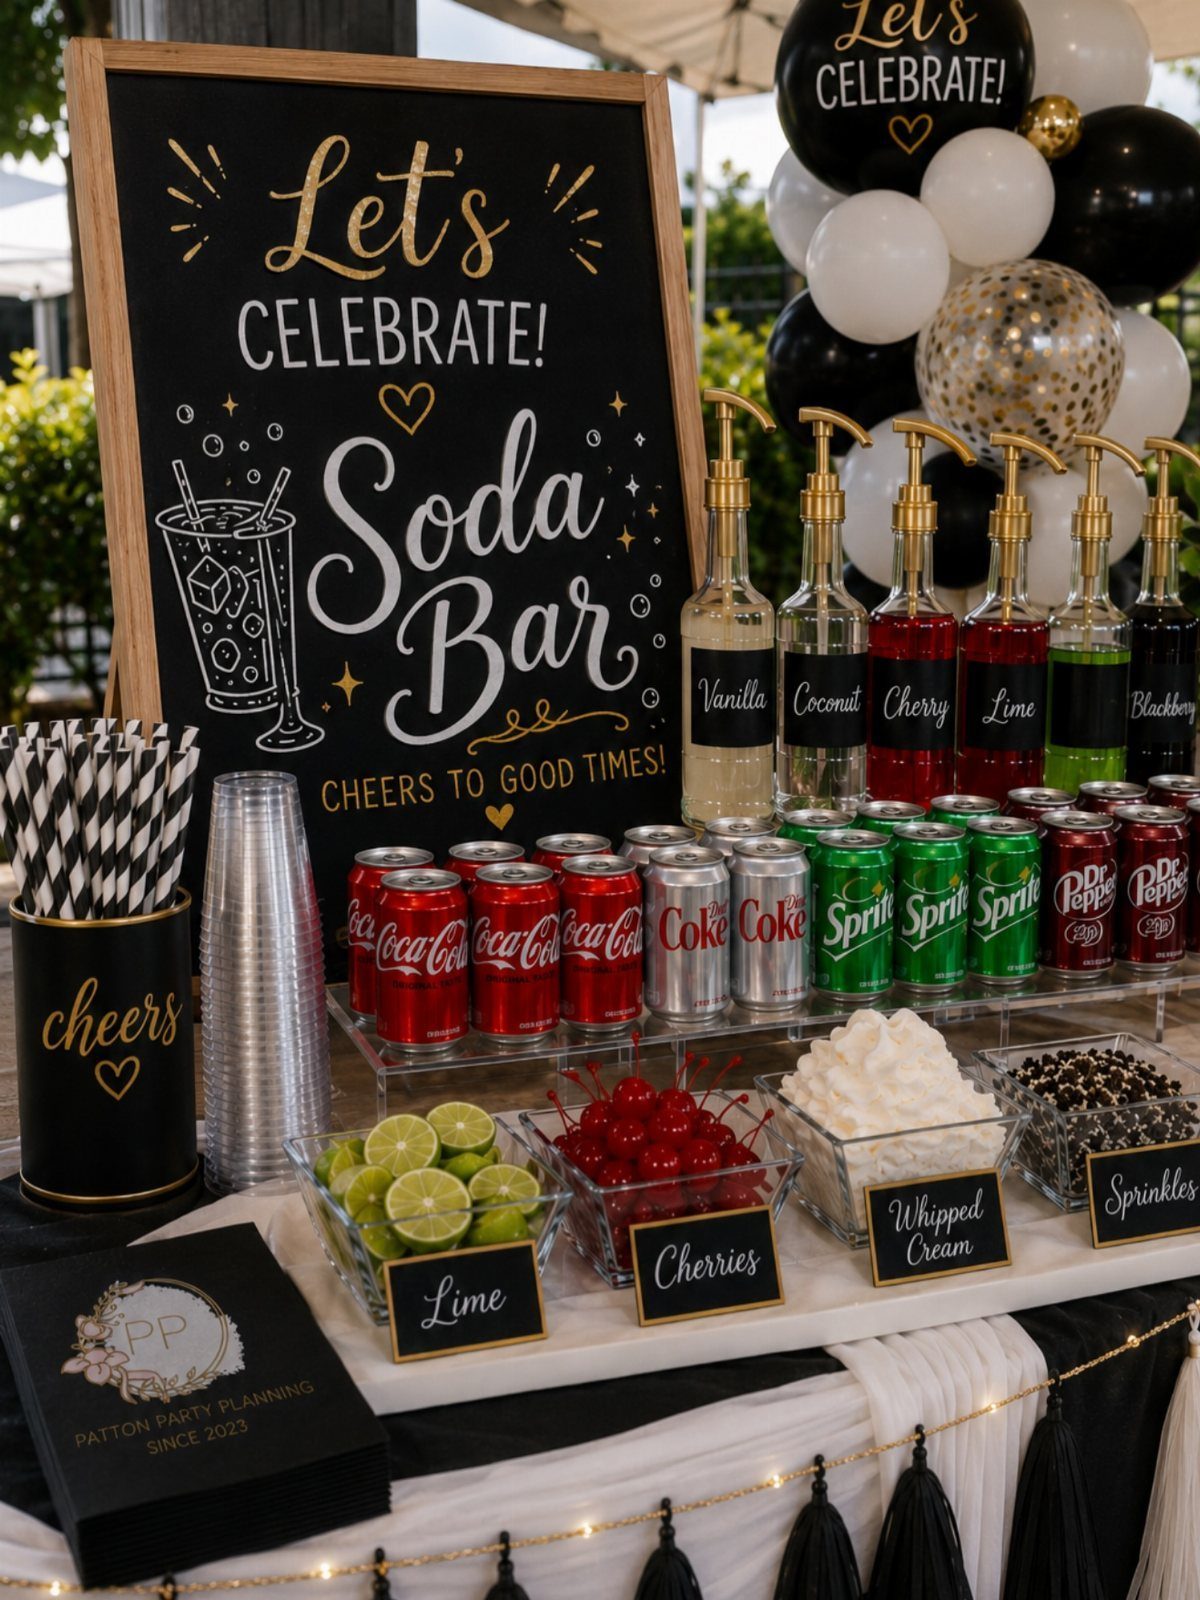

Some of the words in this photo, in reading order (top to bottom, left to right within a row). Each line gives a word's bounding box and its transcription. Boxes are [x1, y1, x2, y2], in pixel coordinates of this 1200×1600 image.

[834, 0, 978, 51] Lets
[816, 56, 1006, 110] CELEBRATE!
[264, 134, 510, 281] Let's
[237, 296, 547, 370] CELEBRATE!
[307, 408, 605, 635] Soda
[385, 575, 639, 745] Bar
[698, 678, 767, 713] Vanilla
[793, 681, 863, 716] Coconut
[884, 685, 949, 729] Cherry
[982, 688, 1036, 725] Lime
[322, 773, 435, 812] CHEERS
[447, 768, 484, 799] TO
[499, 757, 574, 795] GOOD
[582, 744, 667, 783] TIMES!
[659, 906, 728, 951] Coke
[739, 898, 806, 943] Coke
[823, 888, 894, 949] Sprite
[902, 880, 968, 940] Sprite
[973, 873, 1040, 931] Sprite
[42, 977, 183, 1057] cheers
[889, 1188, 984, 1237] Whipped
[1105, 1166, 1199, 1221] Sprinkles
[654, 1242, 761, 1290] Cherries
[907, 1232, 973, 1266] Cream
[420, 1274, 507, 1330] Lime
[125, 1314, 187, 1356] PP
[75, 1419, 150, 1447] PATTON
[156, 1403, 212, 1429] PARTY
[218, 1380, 314, 1414] PLANNING
[146, 1430, 200, 1455] SINCE
[207, 1418, 248, 1442] 2023
